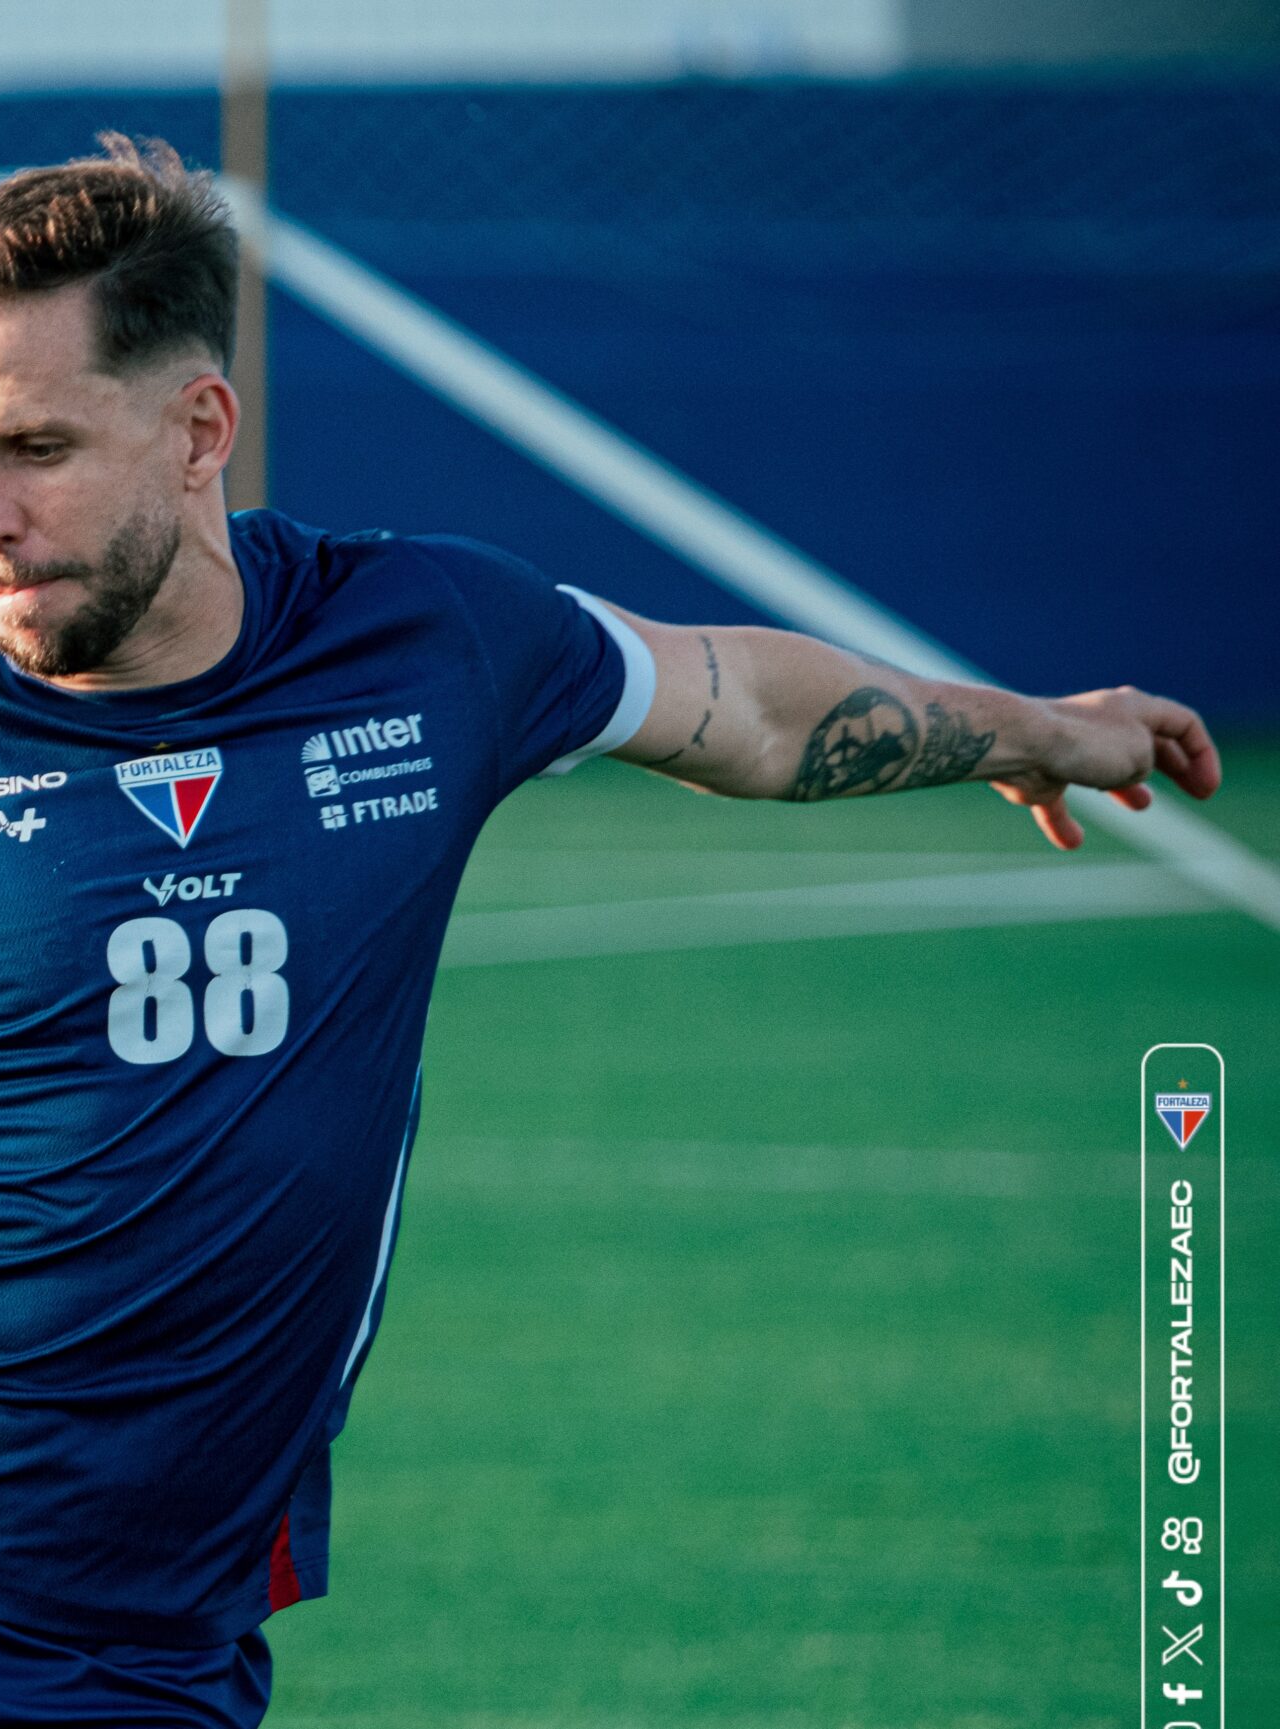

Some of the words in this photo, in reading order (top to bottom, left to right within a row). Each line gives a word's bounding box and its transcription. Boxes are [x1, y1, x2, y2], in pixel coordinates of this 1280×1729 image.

[331, 713, 422, 757] inter
[120, 751, 218, 779] FORTALEZA
[352, 787, 439, 824] FTRADE
[142, 872, 242, 907] VOLT
[106, 908, 290, 1065] 88
